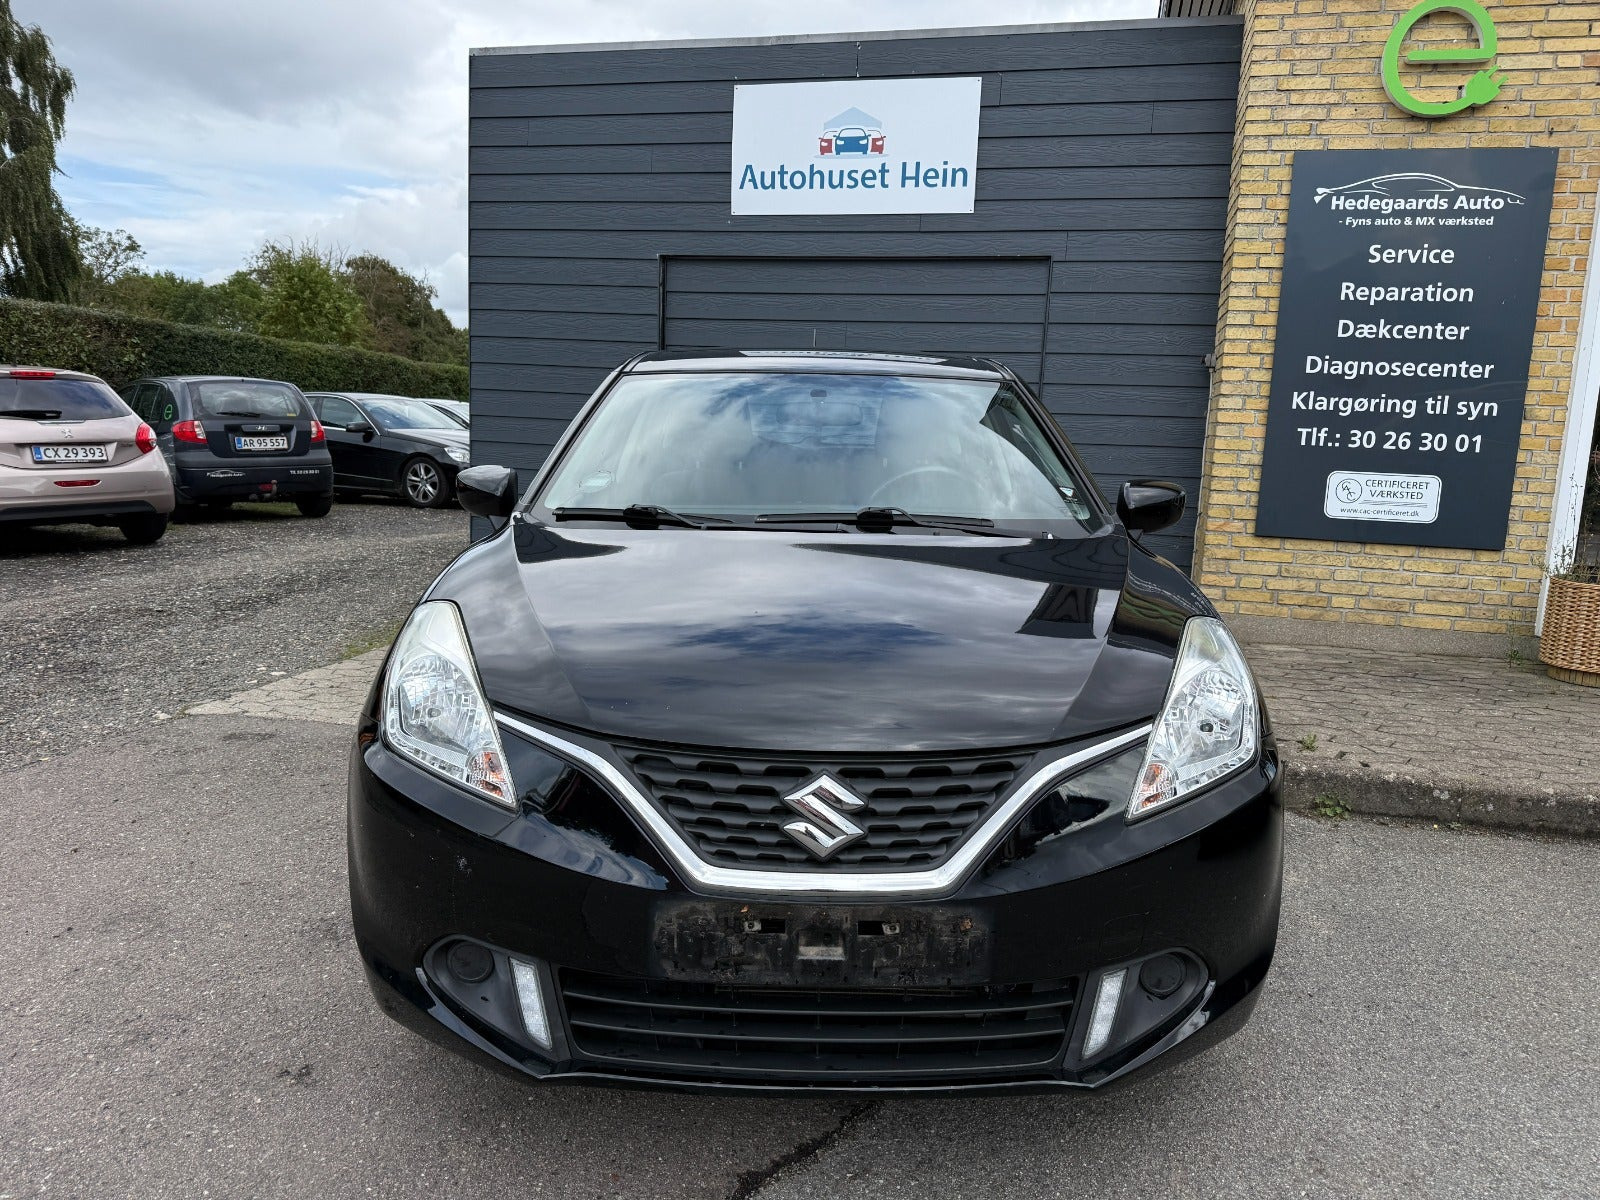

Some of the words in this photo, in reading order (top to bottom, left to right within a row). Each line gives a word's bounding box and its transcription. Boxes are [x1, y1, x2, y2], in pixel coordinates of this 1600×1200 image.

[738, 163, 890, 190] Autohuset
[900, 161, 969, 188] Hein
[1330, 194, 1449, 214] Hedegaards
[1453, 195, 1505, 210] Auto
[1345, 216, 1372, 228] Fyns
[1374, 216, 1401, 226] auto
[1403, 217, 1413, 226] &
[1415, 217, 1436, 226] MX
[1438, 216, 1495, 226] værksted
[1368, 243, 1455, 264] Service
[1340, 281, 1474, 305] Reparation
[1337, 319, 1470, 340] Dækcenter
[1305, 355, 1495, 380] Diagnosecenter
[1291, 391, 1417, 419] Klargøring
[1425, 395, 1450, 415] til
[1456, 400, 1499, 421] syn
[243, 439, 255, 447] AR
[256, 439, 268, 447] 95
[269, 439, 286, 447] 557
[1297, 427, 1341, 447] Tlf.:
[1348, 429, 1376, 449] 30
[1383, 431, 1412, 450] 26
[1418, 432, 1448, 452] 30
[1454, 434, 1482, 453] 01
[43, 447, 61, 458] CX
[64, 447, 79, 458] 29
[81, 447, 105, 458] 393
[1365, 479, 1430, 490] CERTIFICERET
[1370, 489, 1424, 500] VÆRKSTED
[1340, 507, 1420, 517] www.cac-certificeret.dk
